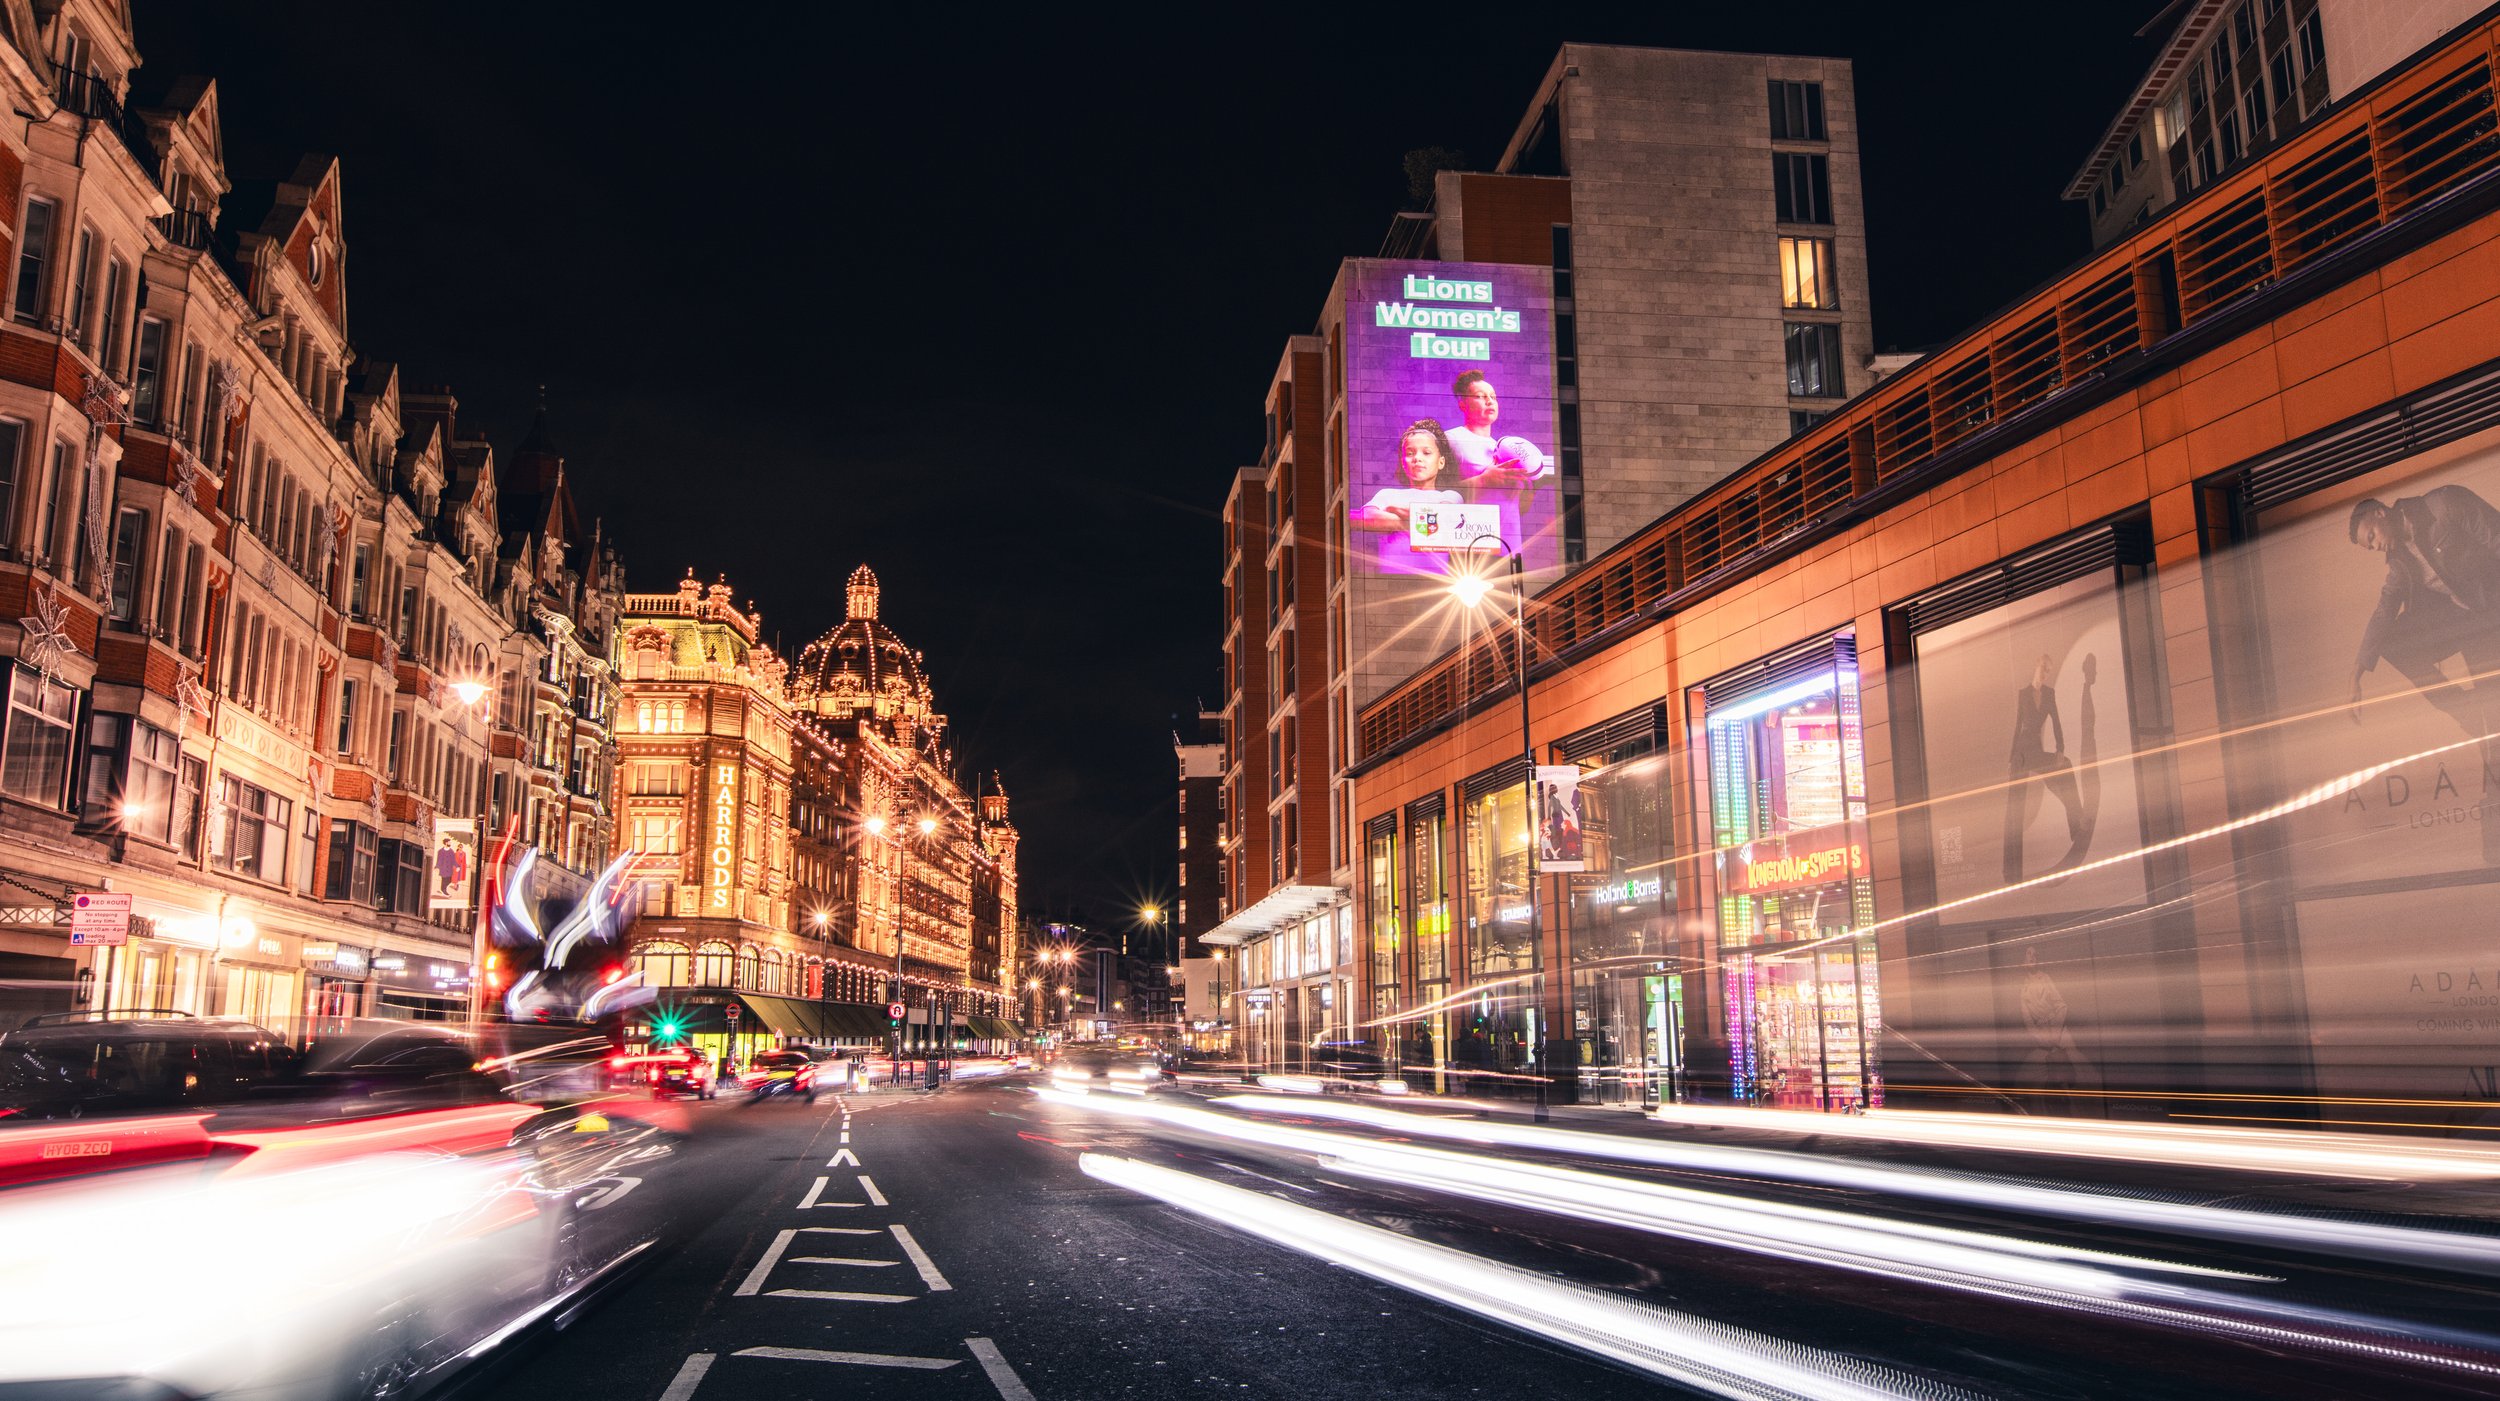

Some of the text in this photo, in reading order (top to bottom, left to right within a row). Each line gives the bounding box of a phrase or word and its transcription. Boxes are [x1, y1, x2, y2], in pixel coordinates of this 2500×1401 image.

[1407, 274, 1489, 300] Lions
[1378, 301, 1517, 330] Women's
[1413, 332, 1485, 357] Tour
[1466, 523, 1494, 533] ROYAL
[712, 765, 735, 908] HARRODS
[1747, 856, 1803, 888] KINGDOM
[1809, 845, 1862, 877] SWEETS
